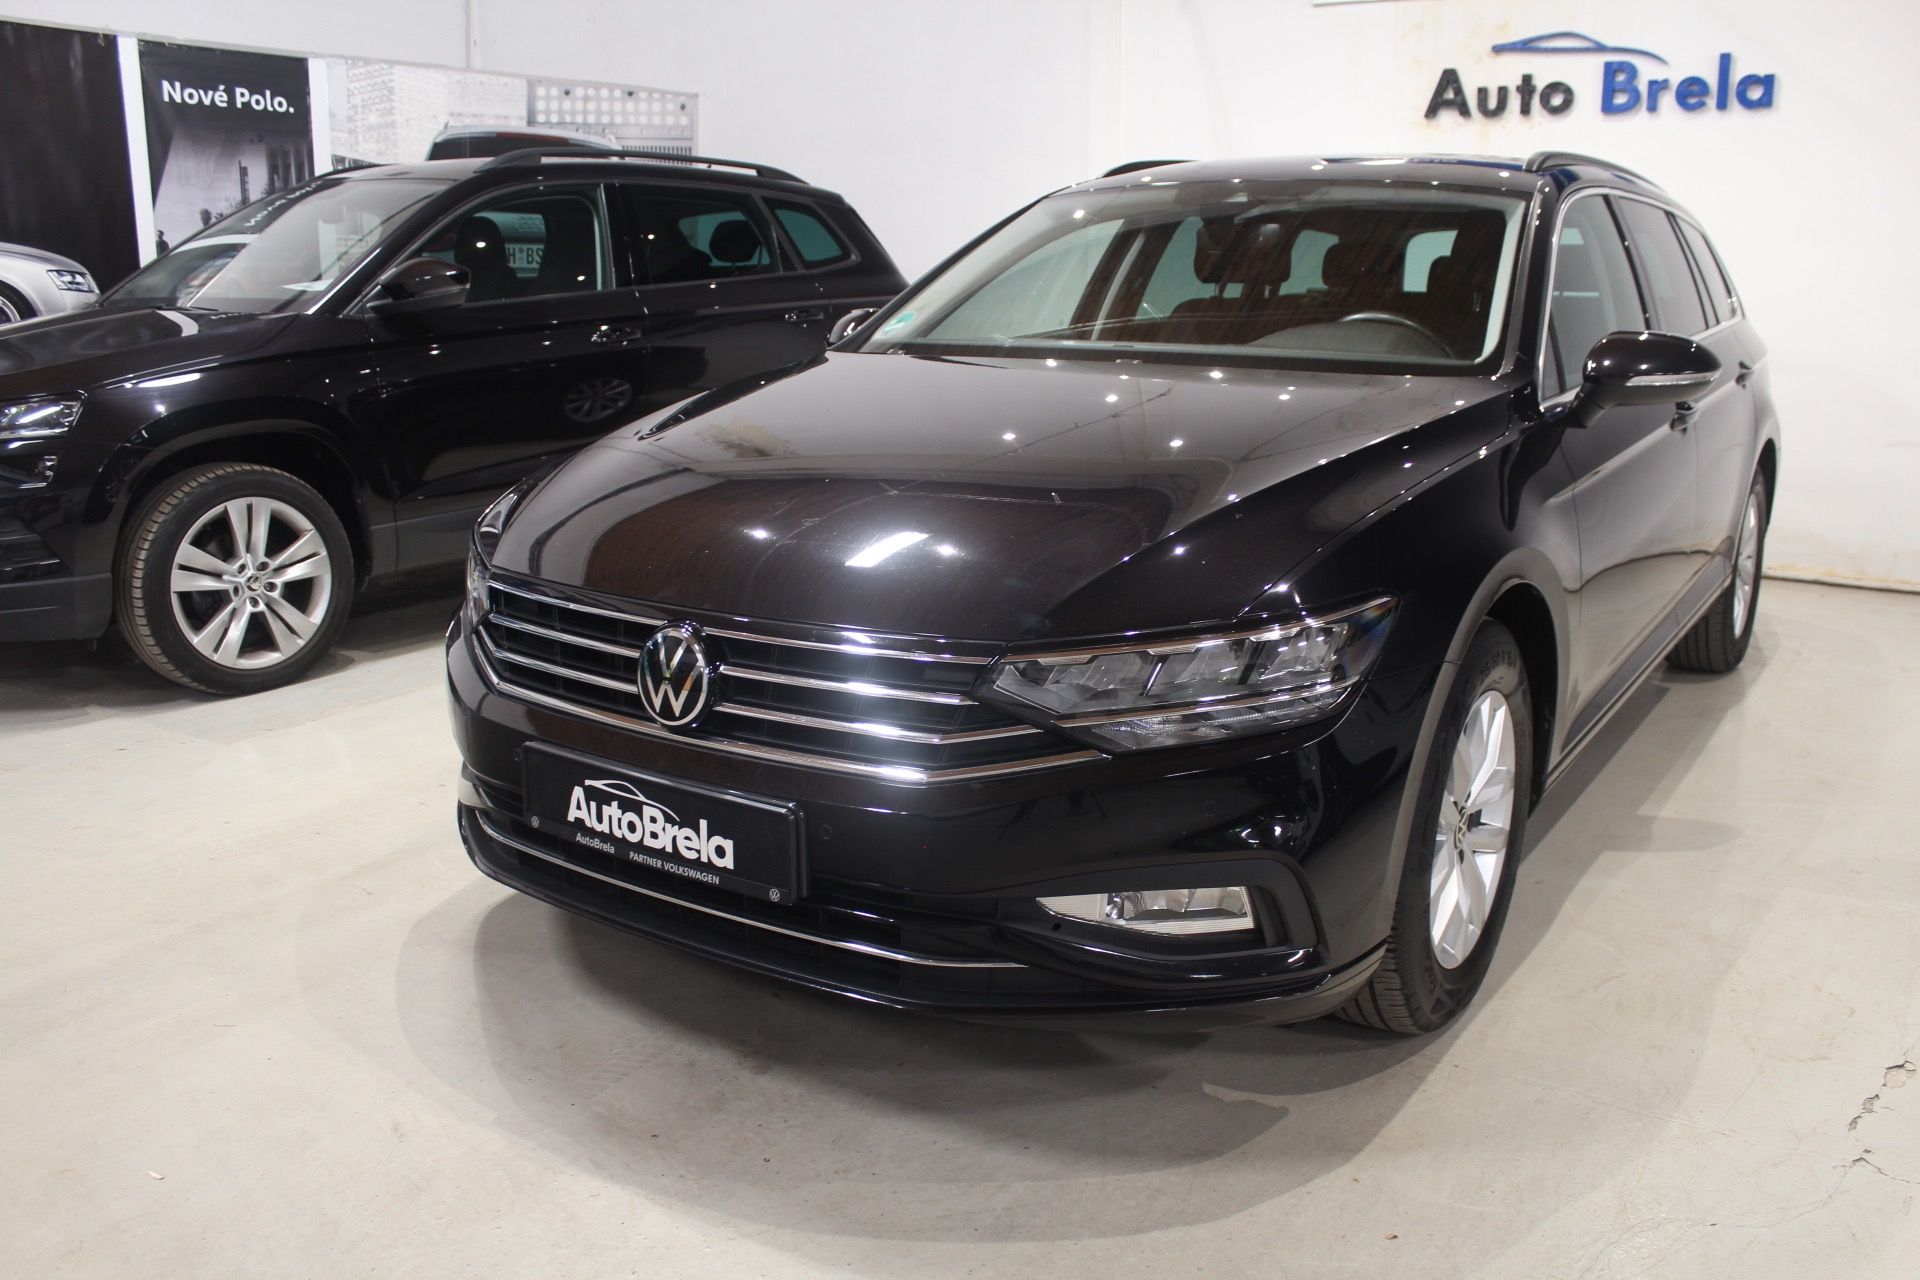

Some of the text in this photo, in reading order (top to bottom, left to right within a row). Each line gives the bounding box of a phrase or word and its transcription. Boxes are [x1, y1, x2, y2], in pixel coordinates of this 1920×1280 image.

[162, 79, 295, 113] Nové Polo.
[1425, 53, 1776, 119] Auto Brela
[567, 786, 734, 870] AutoBrela
[576, 832, 720, 885] AutoBrela PARTNER VOLKSWAGEN
